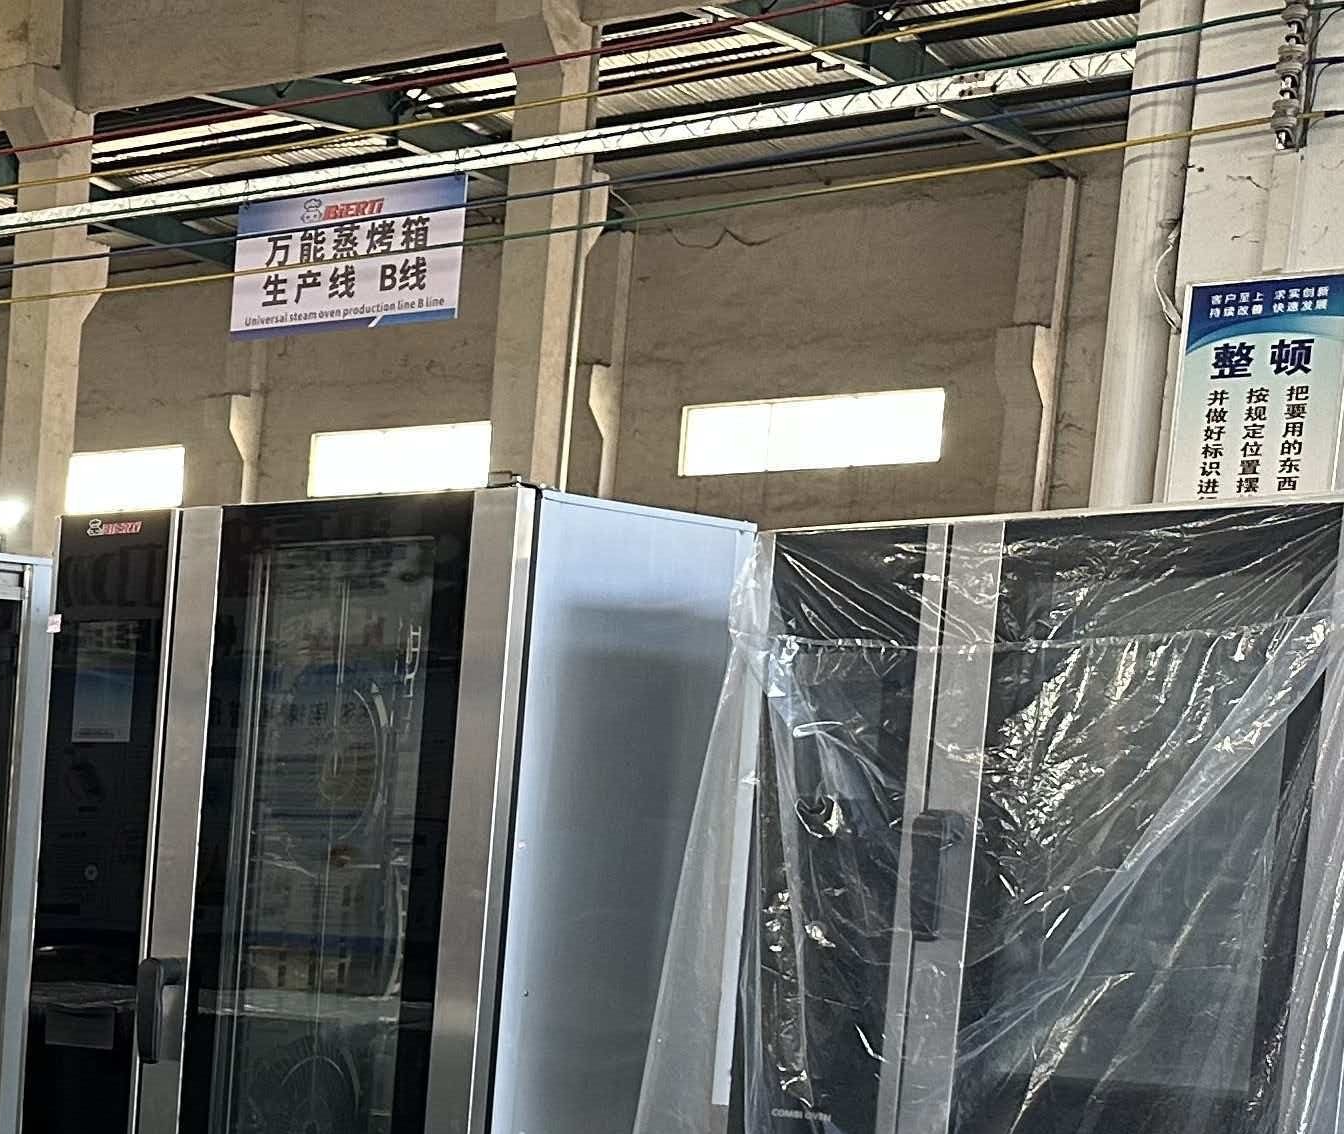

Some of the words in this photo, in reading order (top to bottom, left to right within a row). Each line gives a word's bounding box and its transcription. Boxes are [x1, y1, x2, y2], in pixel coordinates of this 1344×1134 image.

[265, 216, 430, 267] 万能蒸烤箱
[262, 264, 356, 307] 生产线
[379, 256, 427, 292] B线
[244, 315, 288, 327] Universal
[290, 311, 318, 322] steam
[318, 308, 341, 318] oven
[342, 302, 396, 319] production
[397, 300, 415, 311] line
[417, 300, 424, 308] B
[425, 297, 445, 307] line
[1210, 338, 1315, 379] 整顿
[1196, 389, 1230, 500] 并做好标识进
[1276, 385, 1310, 491] 把要用的东西
[771, 1107, 803, 1119] COMBI
